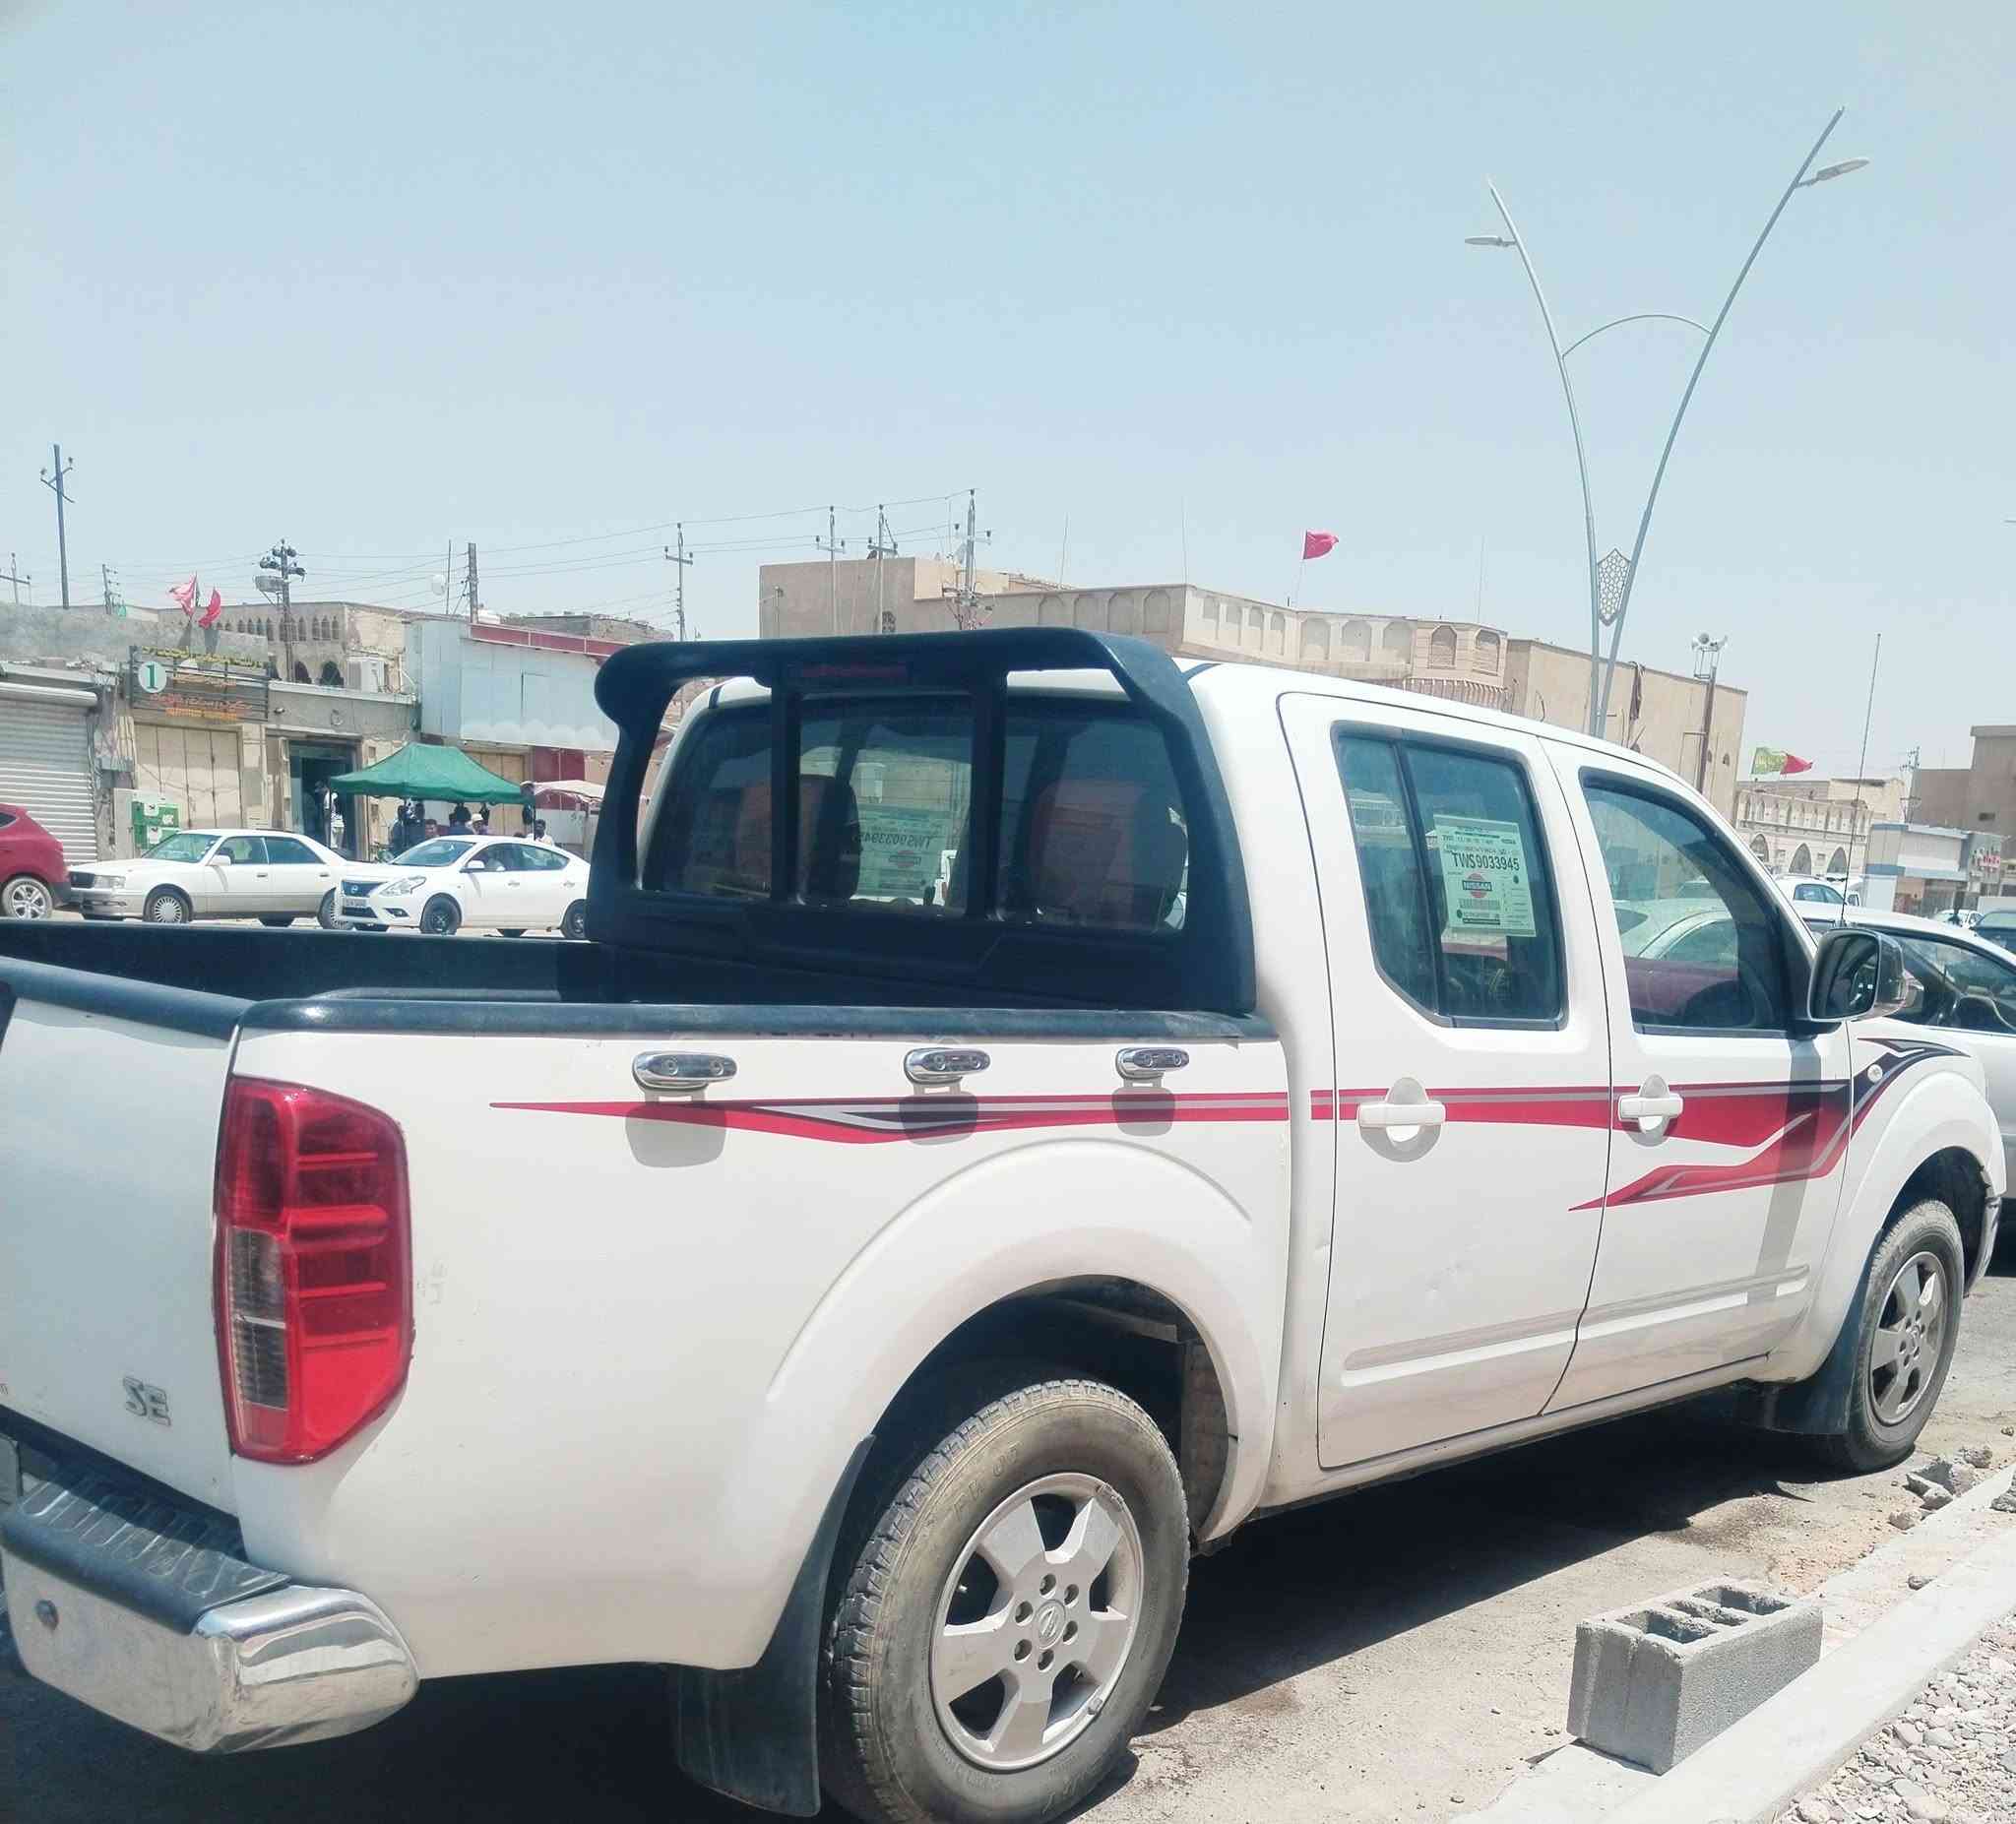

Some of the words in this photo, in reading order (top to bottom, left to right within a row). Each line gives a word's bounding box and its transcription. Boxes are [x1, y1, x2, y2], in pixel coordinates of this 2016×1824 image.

[146, 664, 157, 689] 1
[1451, 851, 1520, 871] TWS9033945
[122, 1376, 171, 1426] SE
